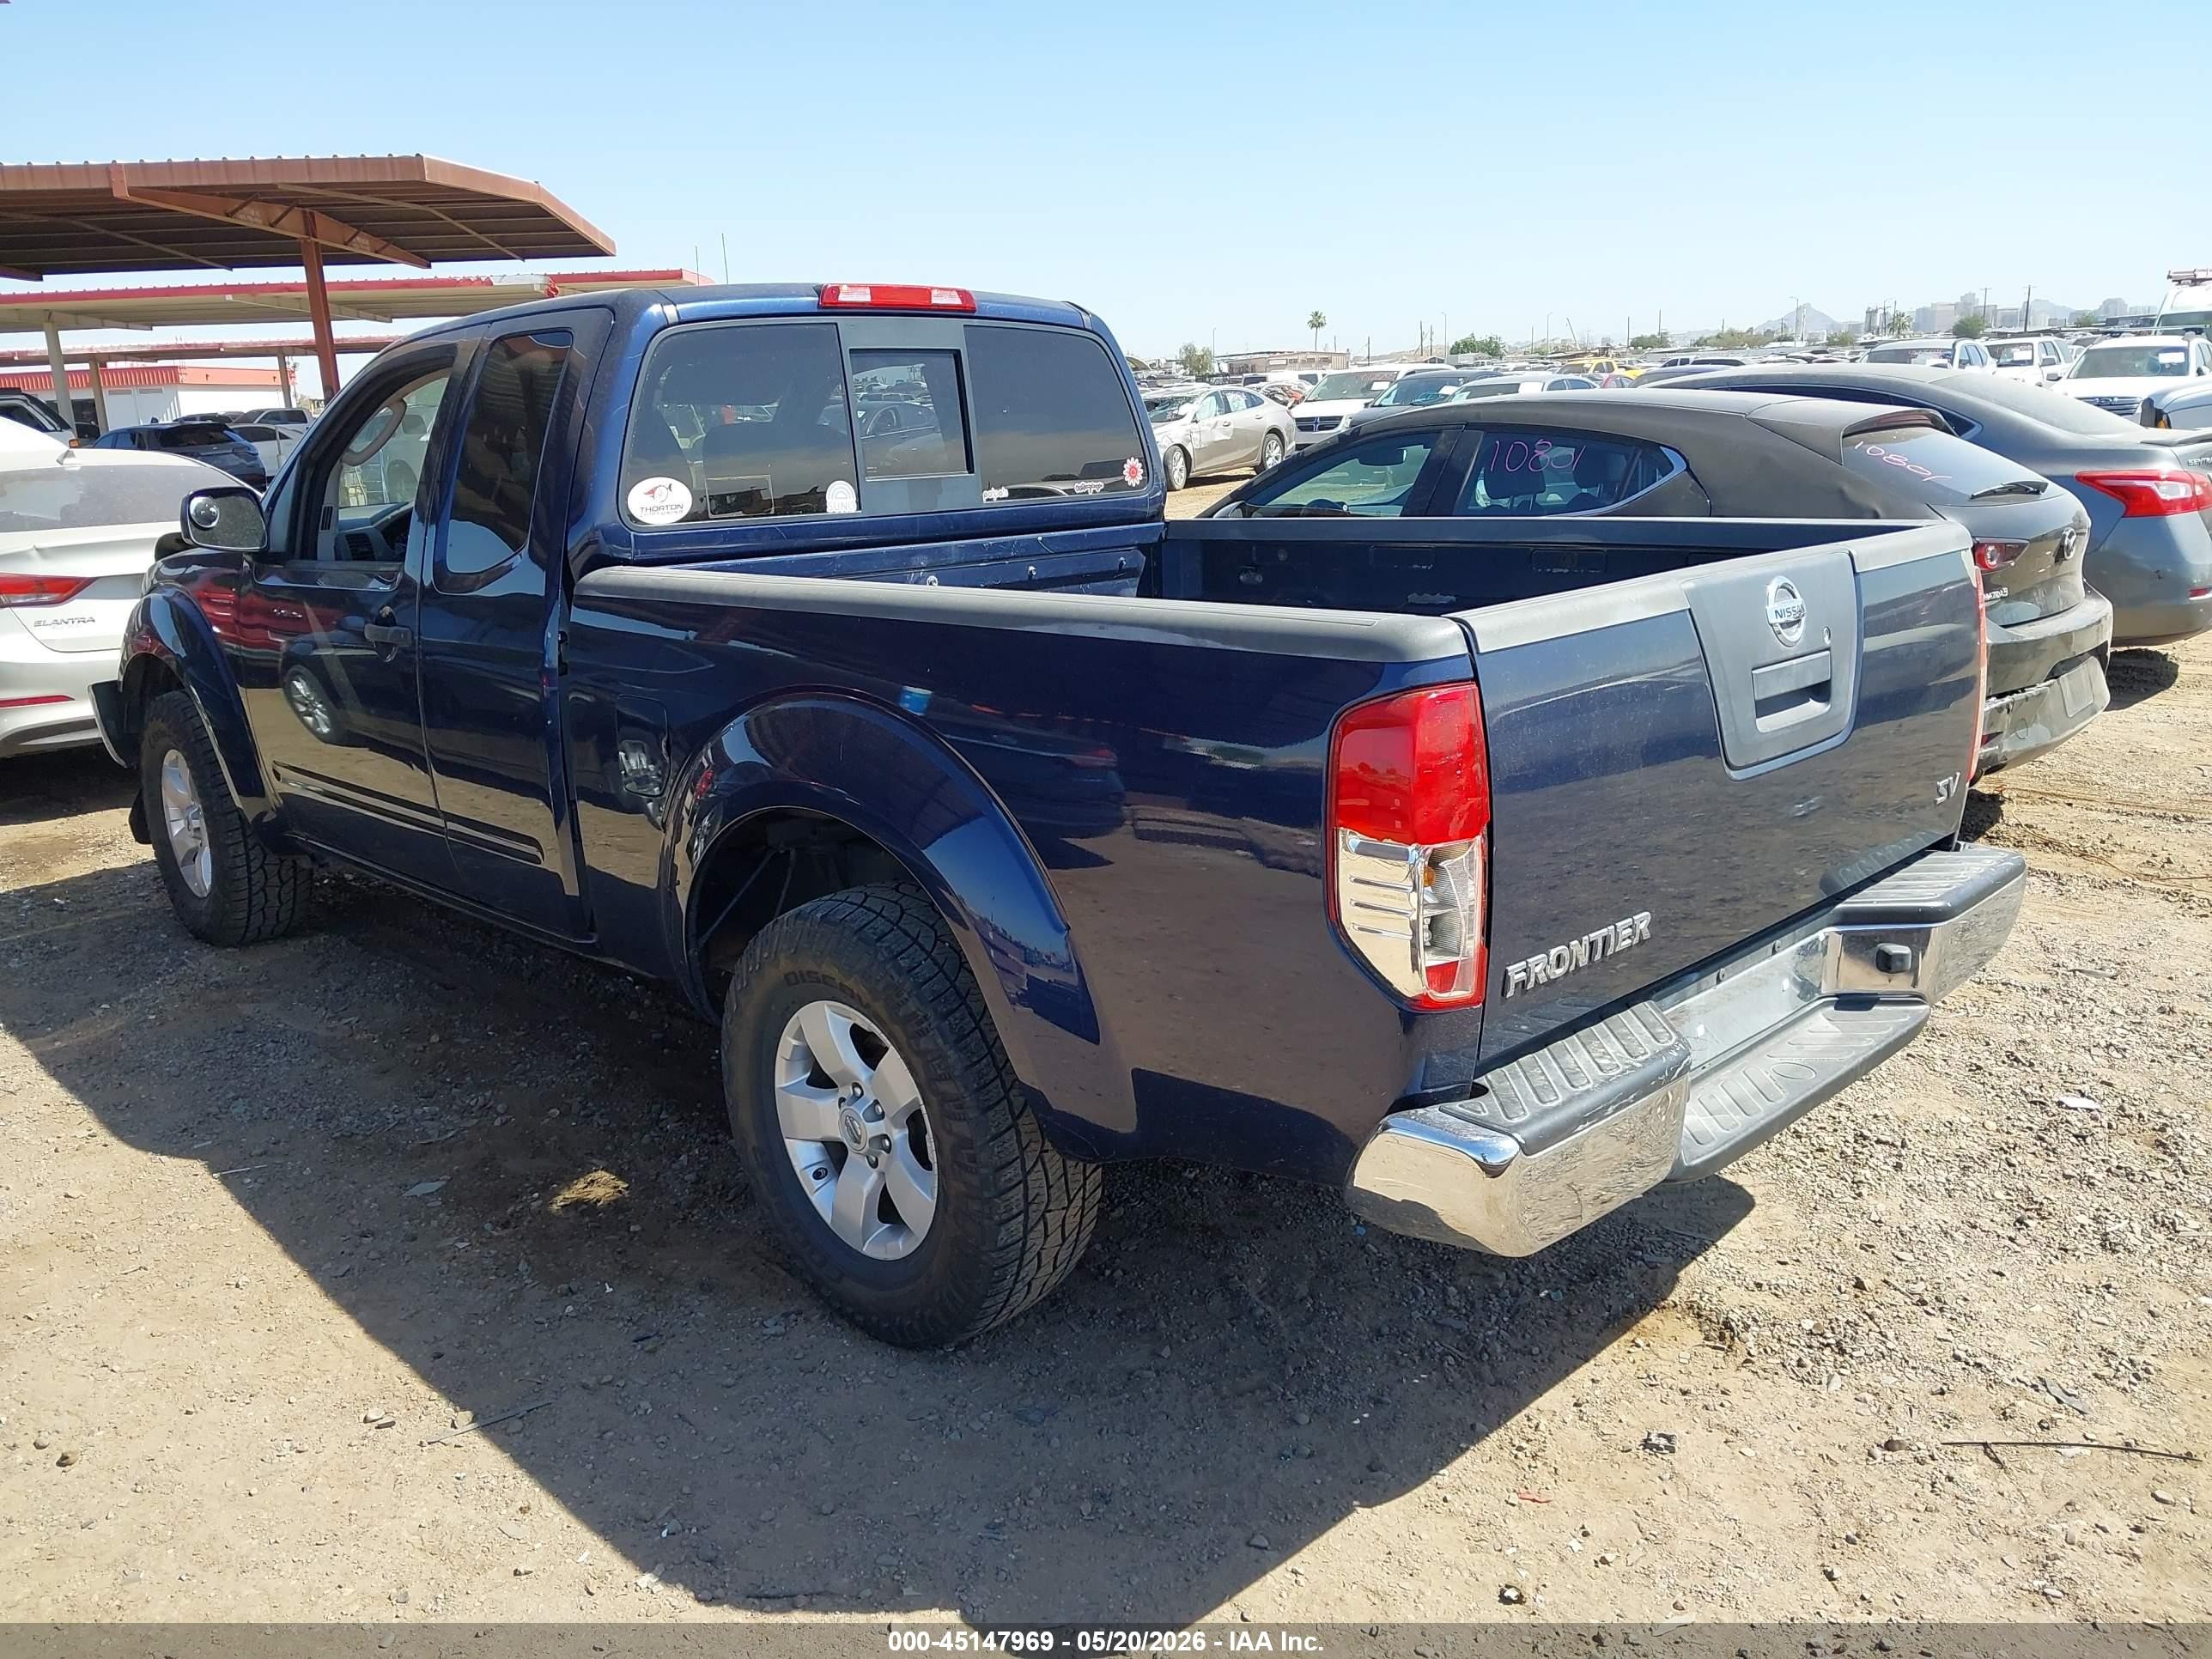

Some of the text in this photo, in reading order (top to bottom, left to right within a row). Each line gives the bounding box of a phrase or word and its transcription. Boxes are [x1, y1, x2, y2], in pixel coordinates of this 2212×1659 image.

[1489, 439, 1586, 472] 10801
[2187, 457, 2212, 466] SENTR
[33, 617, 96, 628] ELANTRA
[1774, 604, 1805, 619] NISSAN
[1934, 771, 1961, 805] SV
[1503, 911, 1651, 999] FRONTIER
